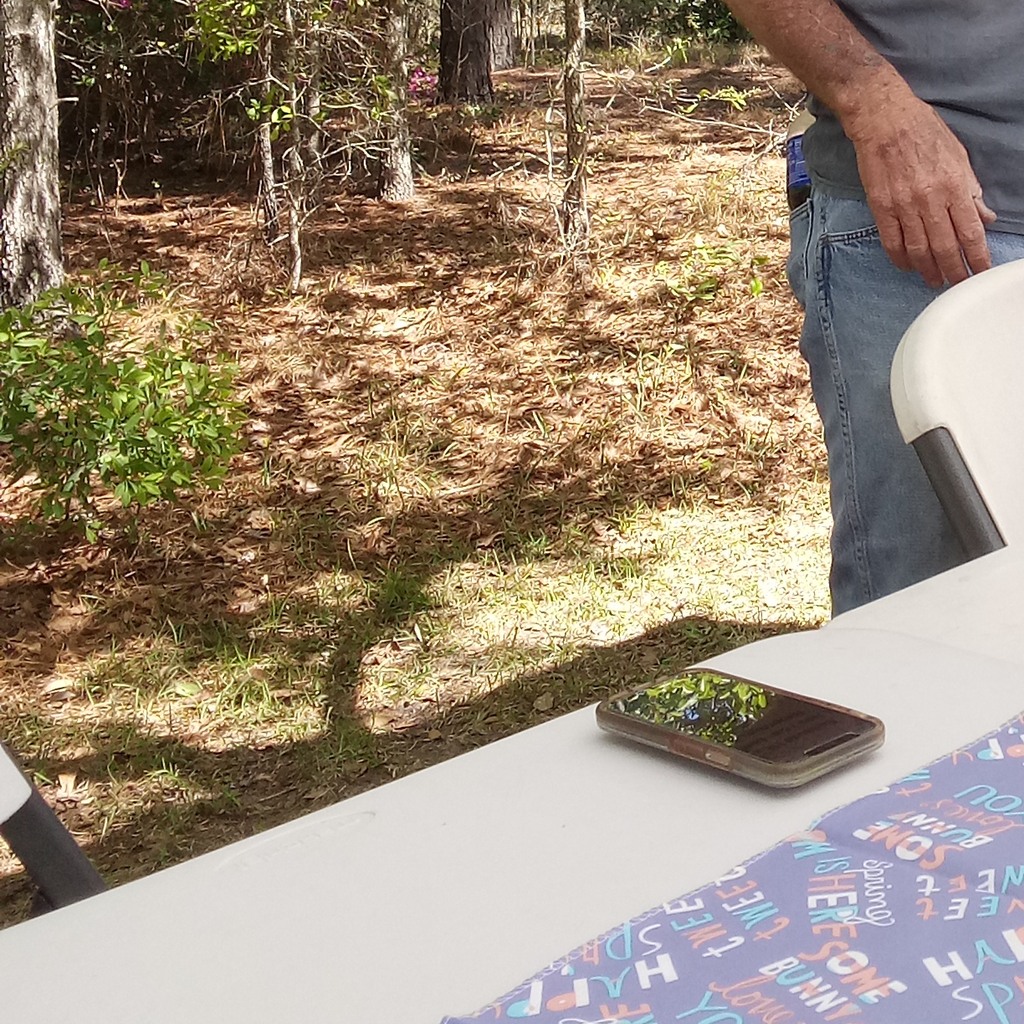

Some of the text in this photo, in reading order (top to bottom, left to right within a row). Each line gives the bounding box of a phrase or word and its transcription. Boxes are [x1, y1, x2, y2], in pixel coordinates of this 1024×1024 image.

[887, 810, 994, 849] BUNNY
[758, 956, 863, 1022] BUNNY
[797, 941, 908, 1004] SOME
